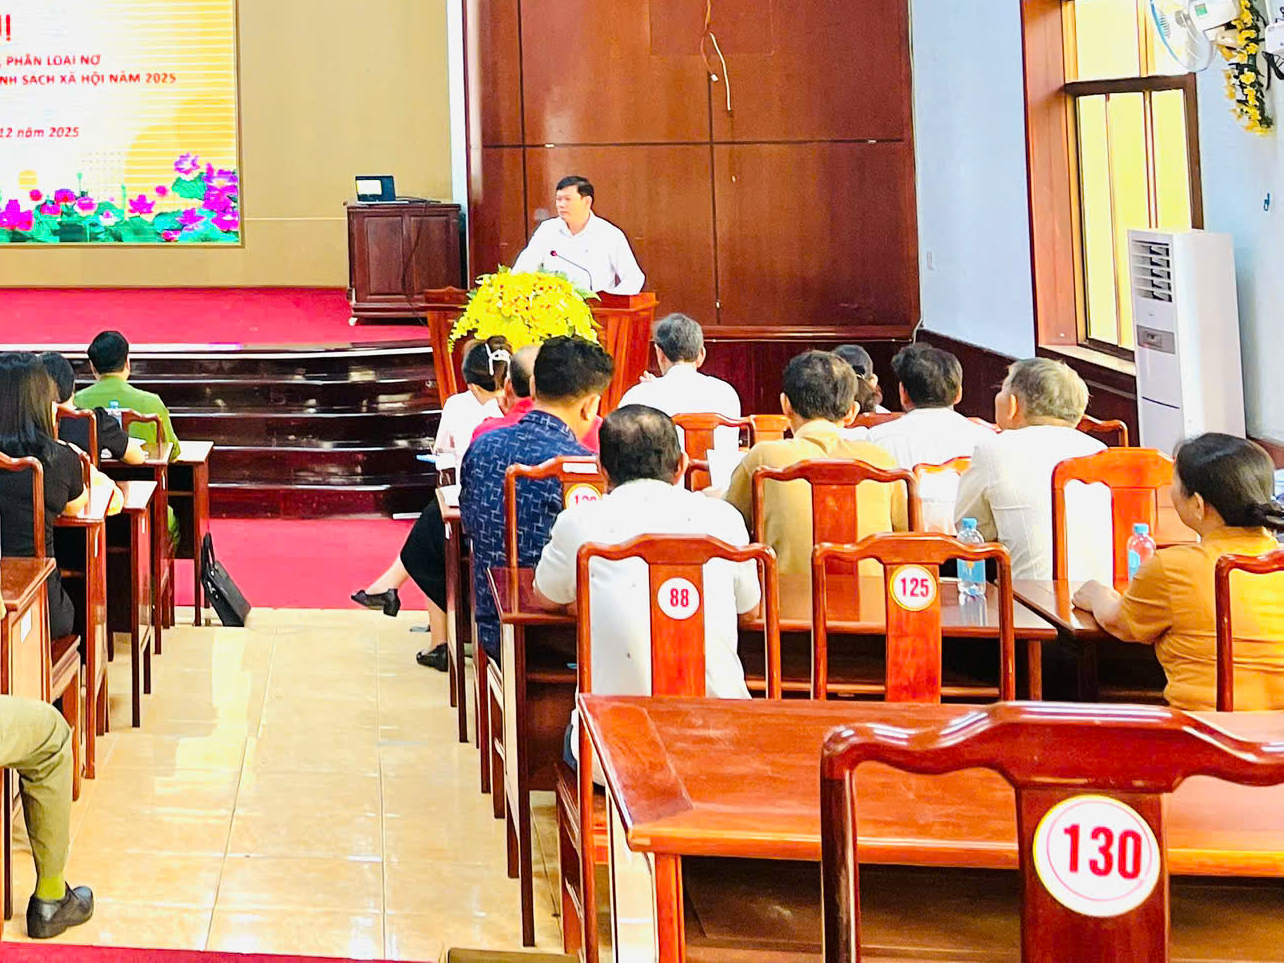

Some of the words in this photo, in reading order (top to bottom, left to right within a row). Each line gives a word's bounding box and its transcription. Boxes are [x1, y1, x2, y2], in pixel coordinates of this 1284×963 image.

[6, 53, 42, 67] PHÂN
[60, 72, 77, 84] XÃ
[81, 71, 105, 87] HỘI
[109, 71, 141, 84] NĂM
[145, 72, 177, 84] 2025
[17, 127, 45, 138] năm
[49, 126, 80, 138] 2025
[900, 577, 929, 598] 125
[669, 588, 689, 607] 88
[1063, 823, 1143, 880] 130
